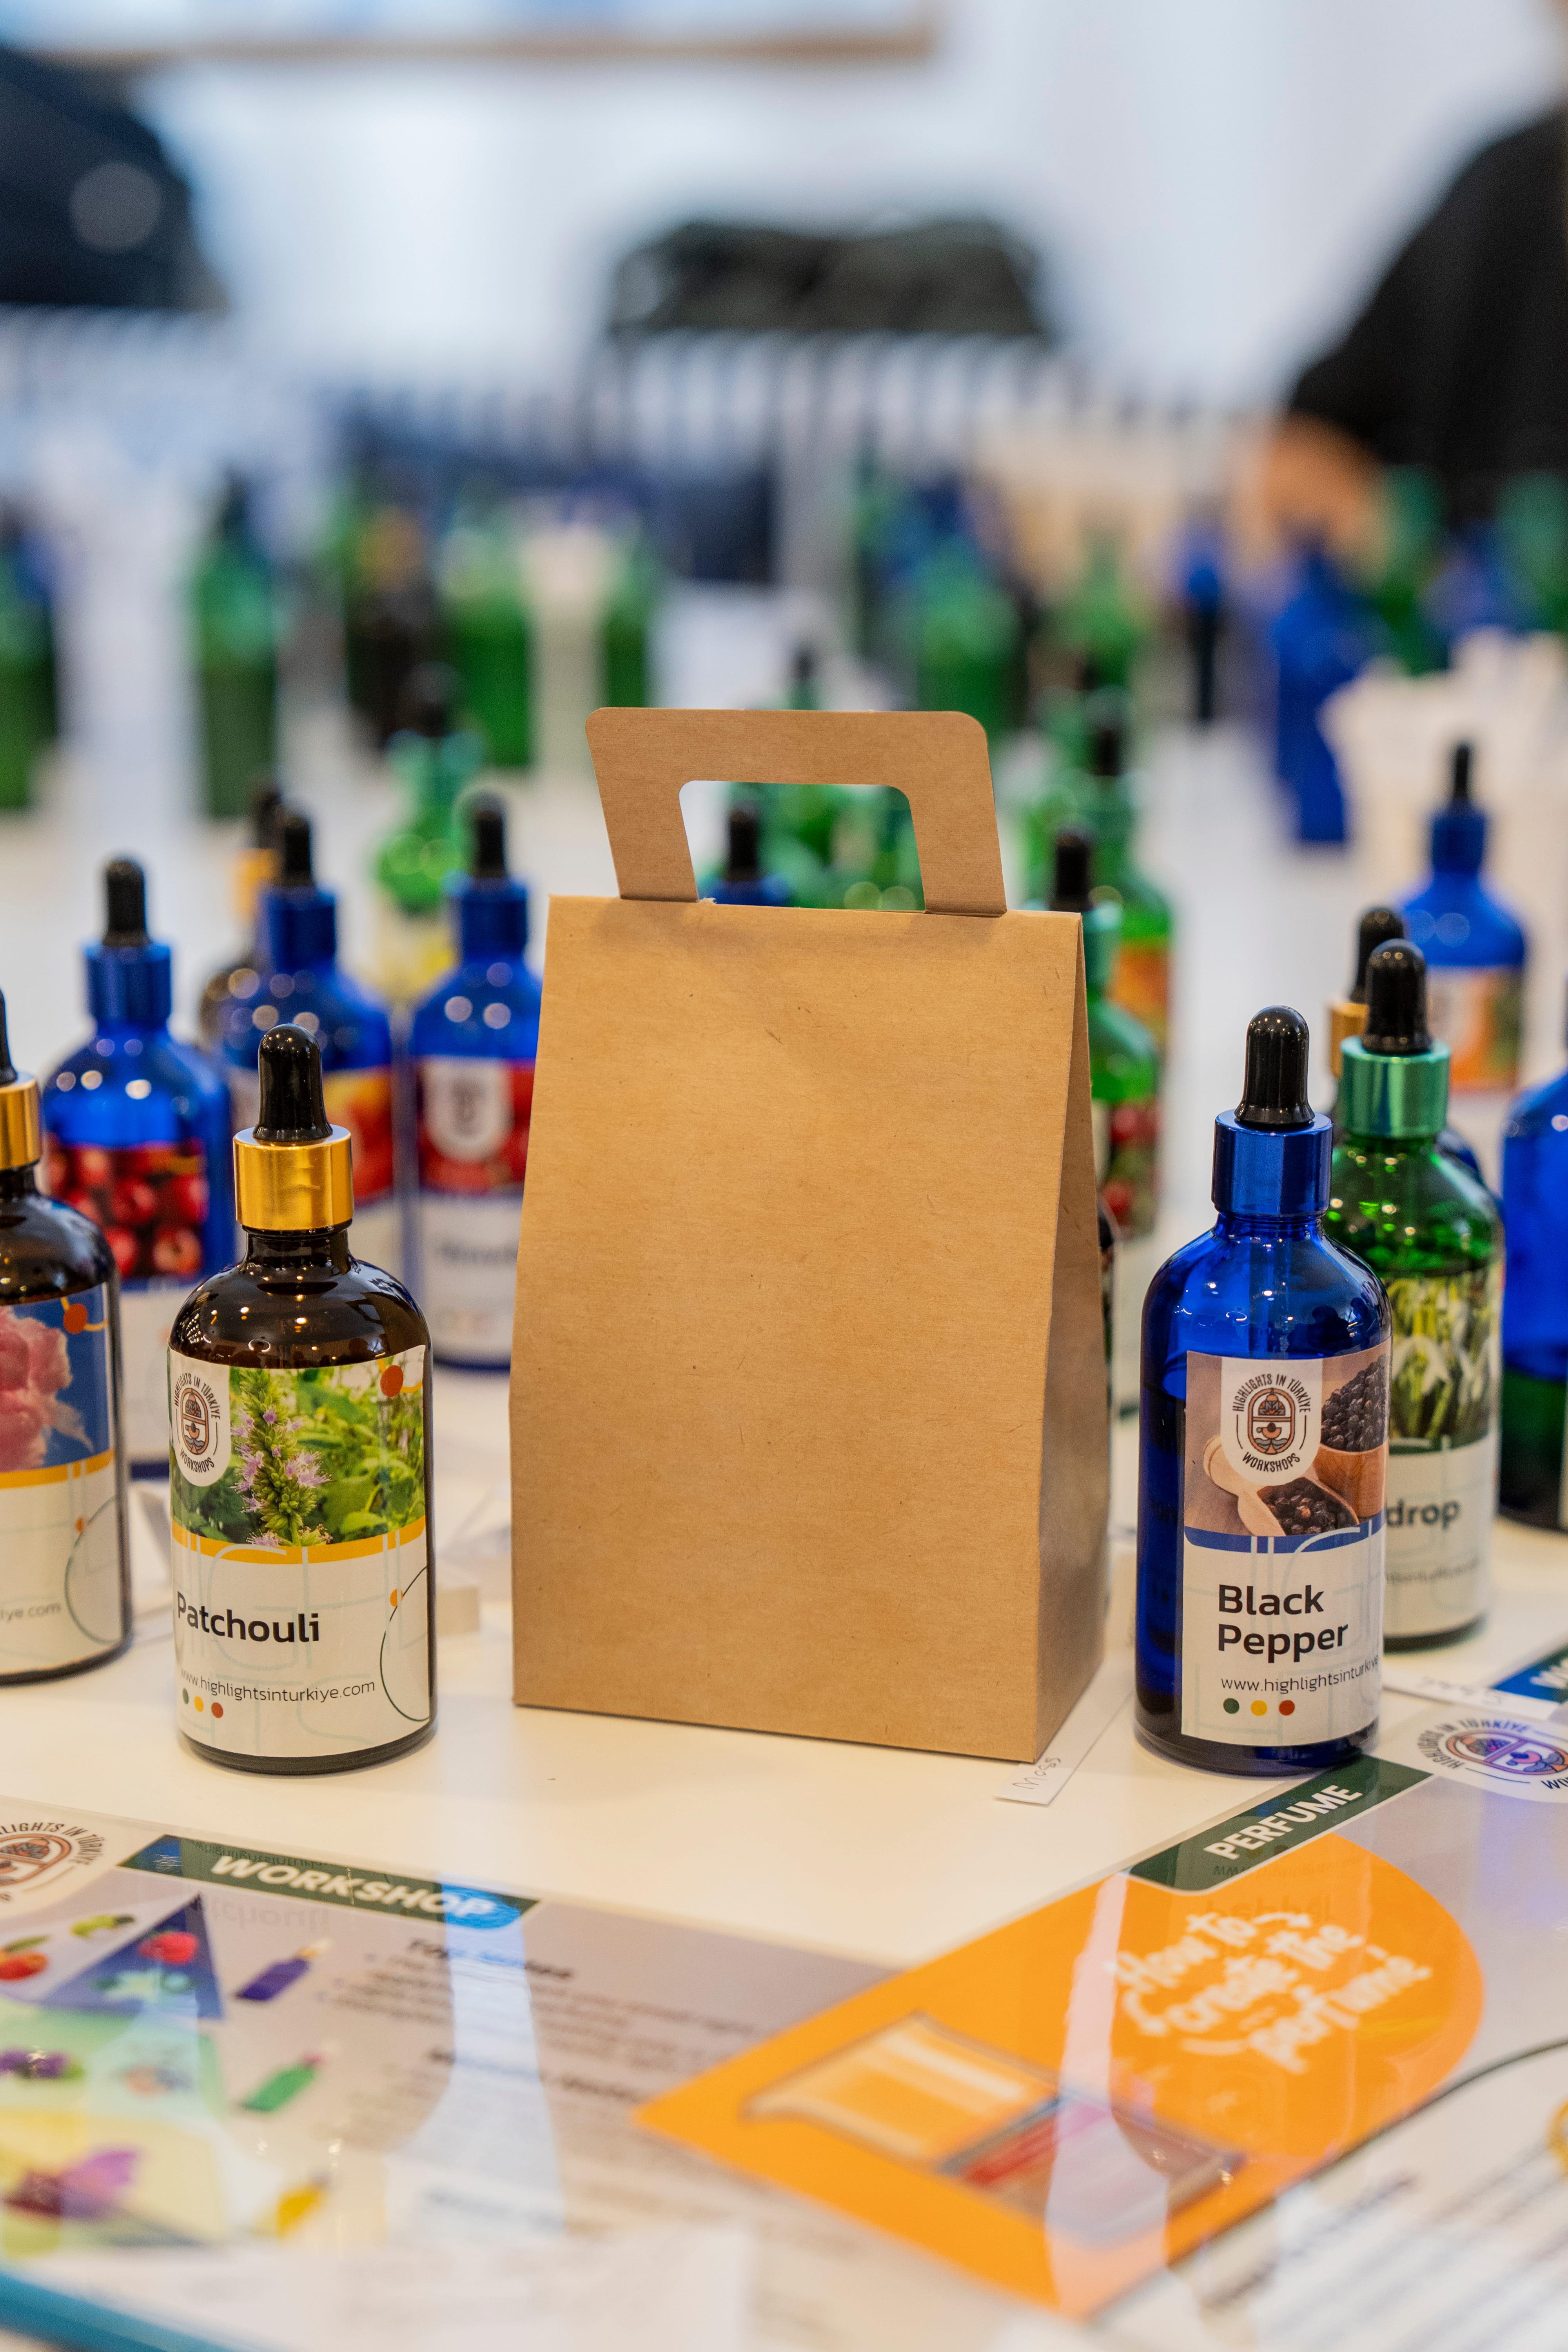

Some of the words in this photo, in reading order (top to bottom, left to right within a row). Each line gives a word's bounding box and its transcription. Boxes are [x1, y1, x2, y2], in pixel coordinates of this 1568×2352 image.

[174, 1373, 192, 1406] HIGHLIGHTS
[194, 1375, 200, 1388] IN
[201, 1383, 220, 1420] TÜRKİYE
[1232, 1374, 1272, 1412] HIGHLIGHTS
[1276, 1374, 1287, 1387] IN
[1287, 1378, 1311, 1413] TÜRKİYE
[180, 1447, 215, 1473] WORKSHOPS
[1242, 1452, 1300, 1473] WORKSHOPS
[177, 1590, 319, 1642] Patchouli
[1218, 1584, 1324, 1615] Black
[1218, 1623, 1348, 1663] Pepper
[180, 1668, 375, 1703] www.highlightsinturkiye.com
[0, 1822, 65, 1835] LIGHTS
[1203, 1784, 1363, 1860] PERFUME
[211, 1855, 497, 1916] WORKSHOP
